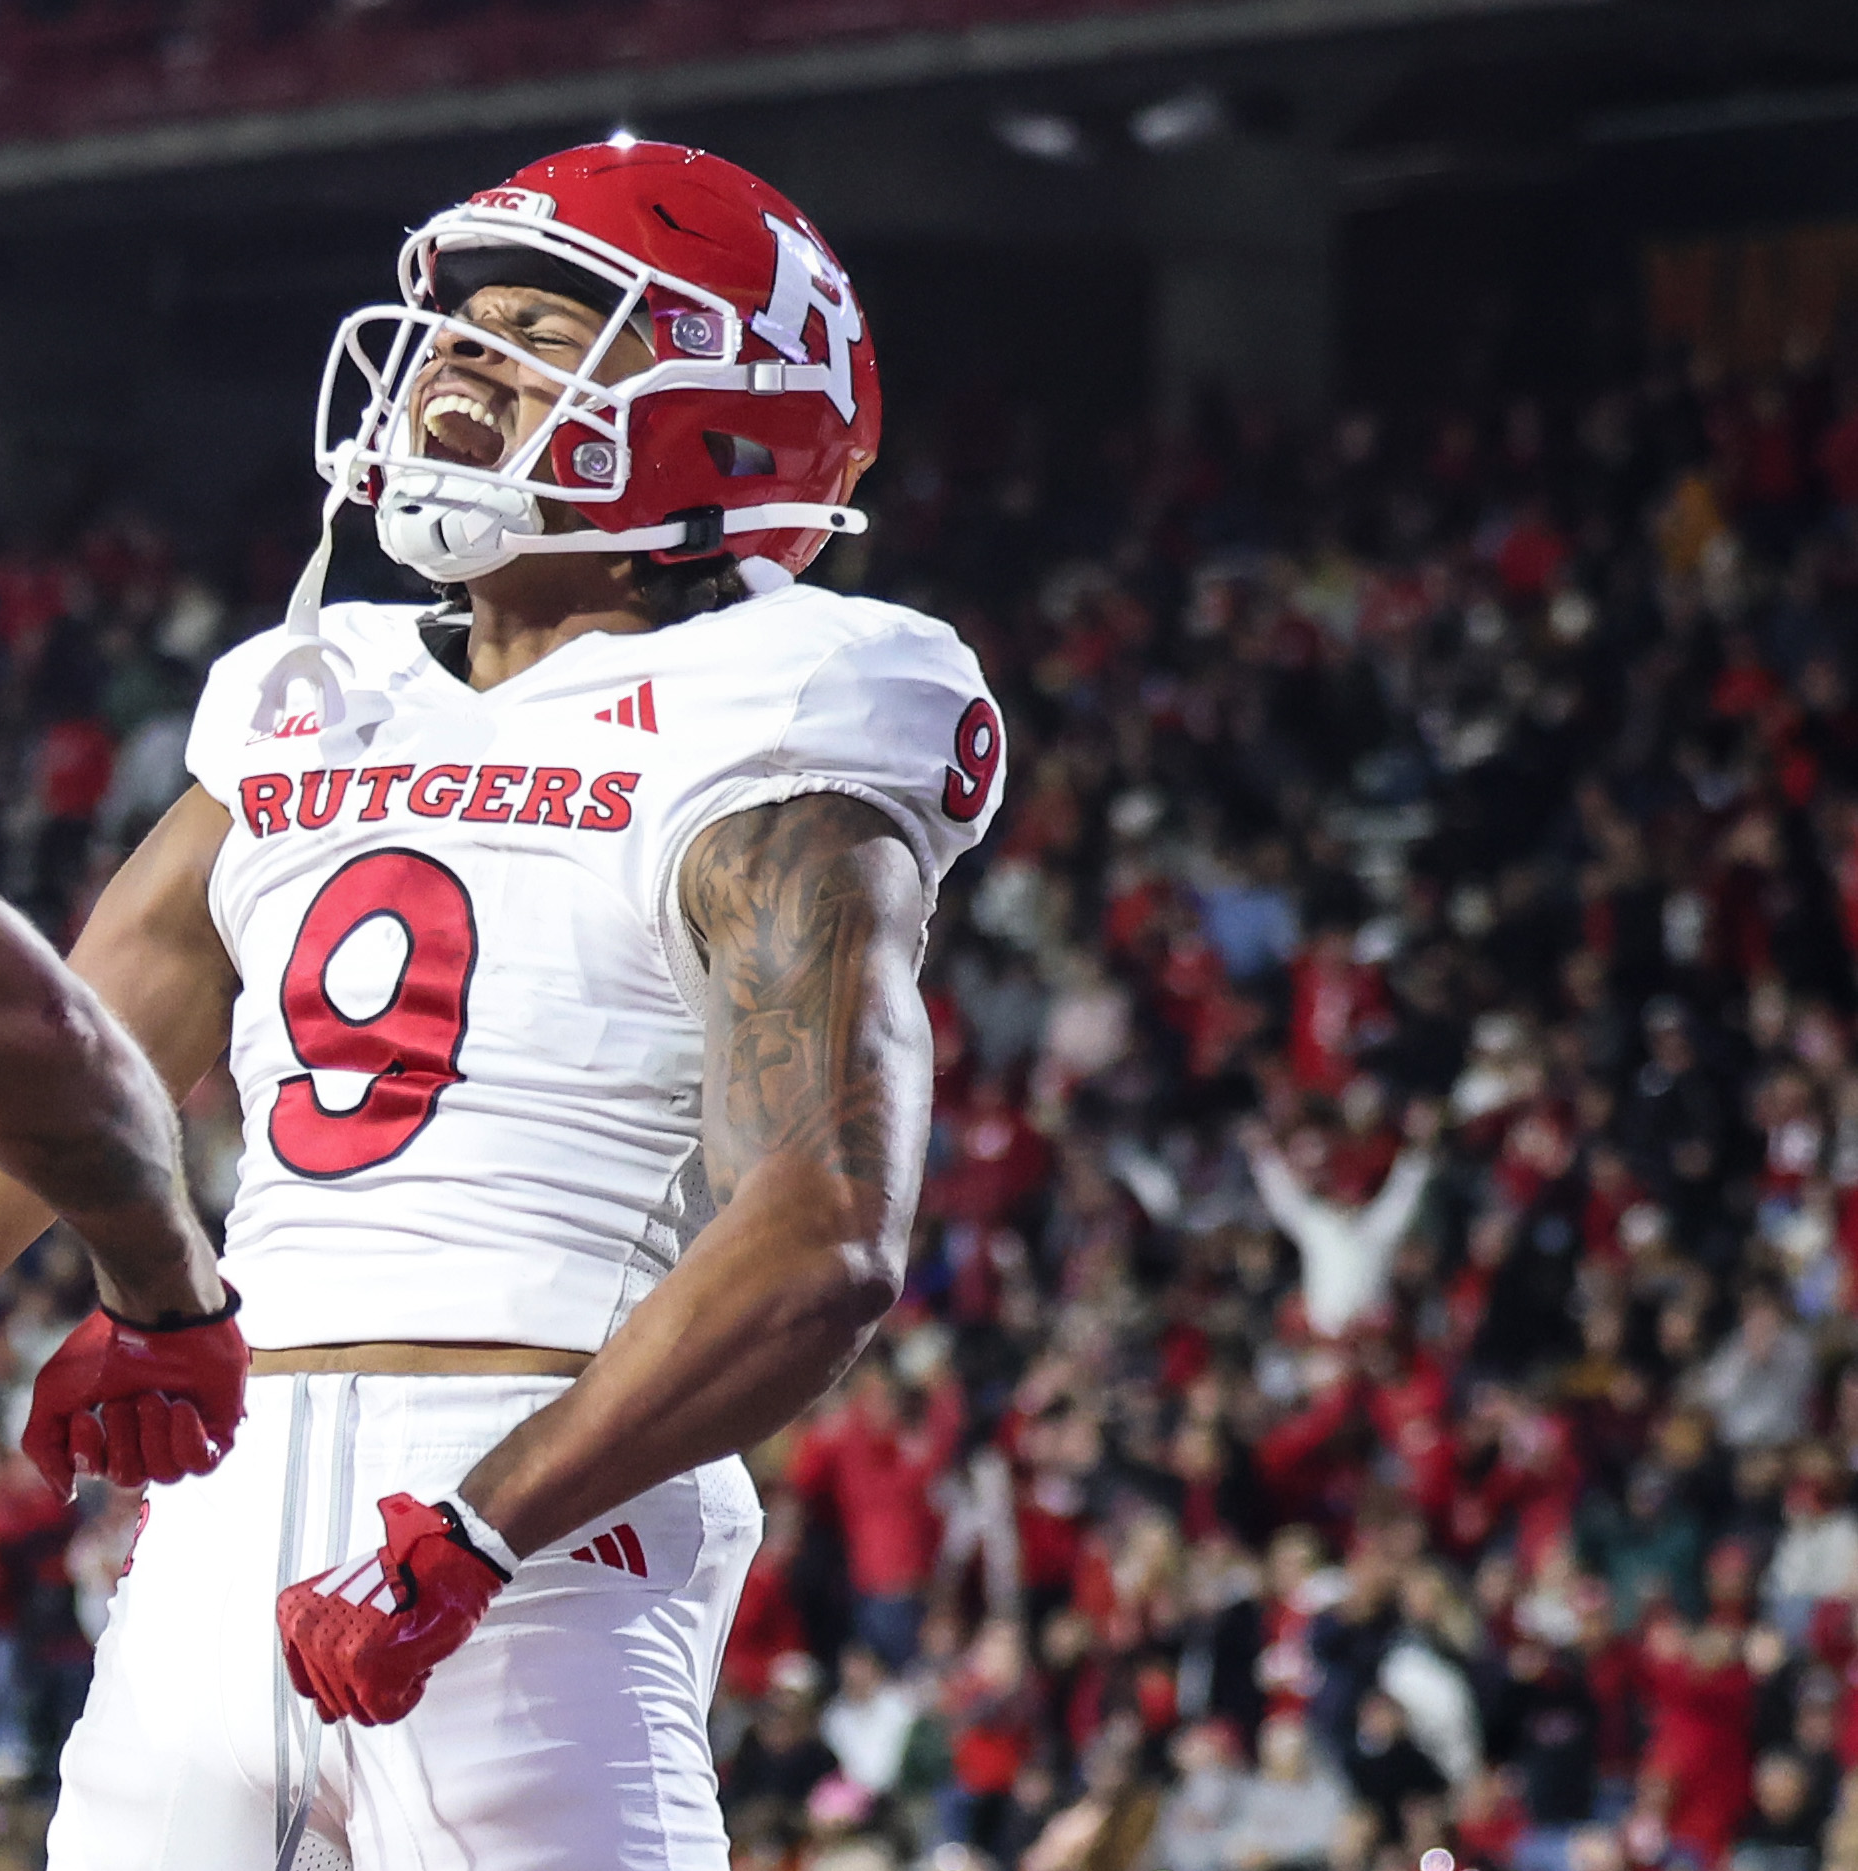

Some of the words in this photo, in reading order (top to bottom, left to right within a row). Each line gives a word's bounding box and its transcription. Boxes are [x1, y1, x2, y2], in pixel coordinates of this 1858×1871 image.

[750, 209, 862, 426] R
[238, 763, 643, 839] RUTGERS
[941, 696, 1003, 823] 9
[268, 846, 479, 1181] 9
